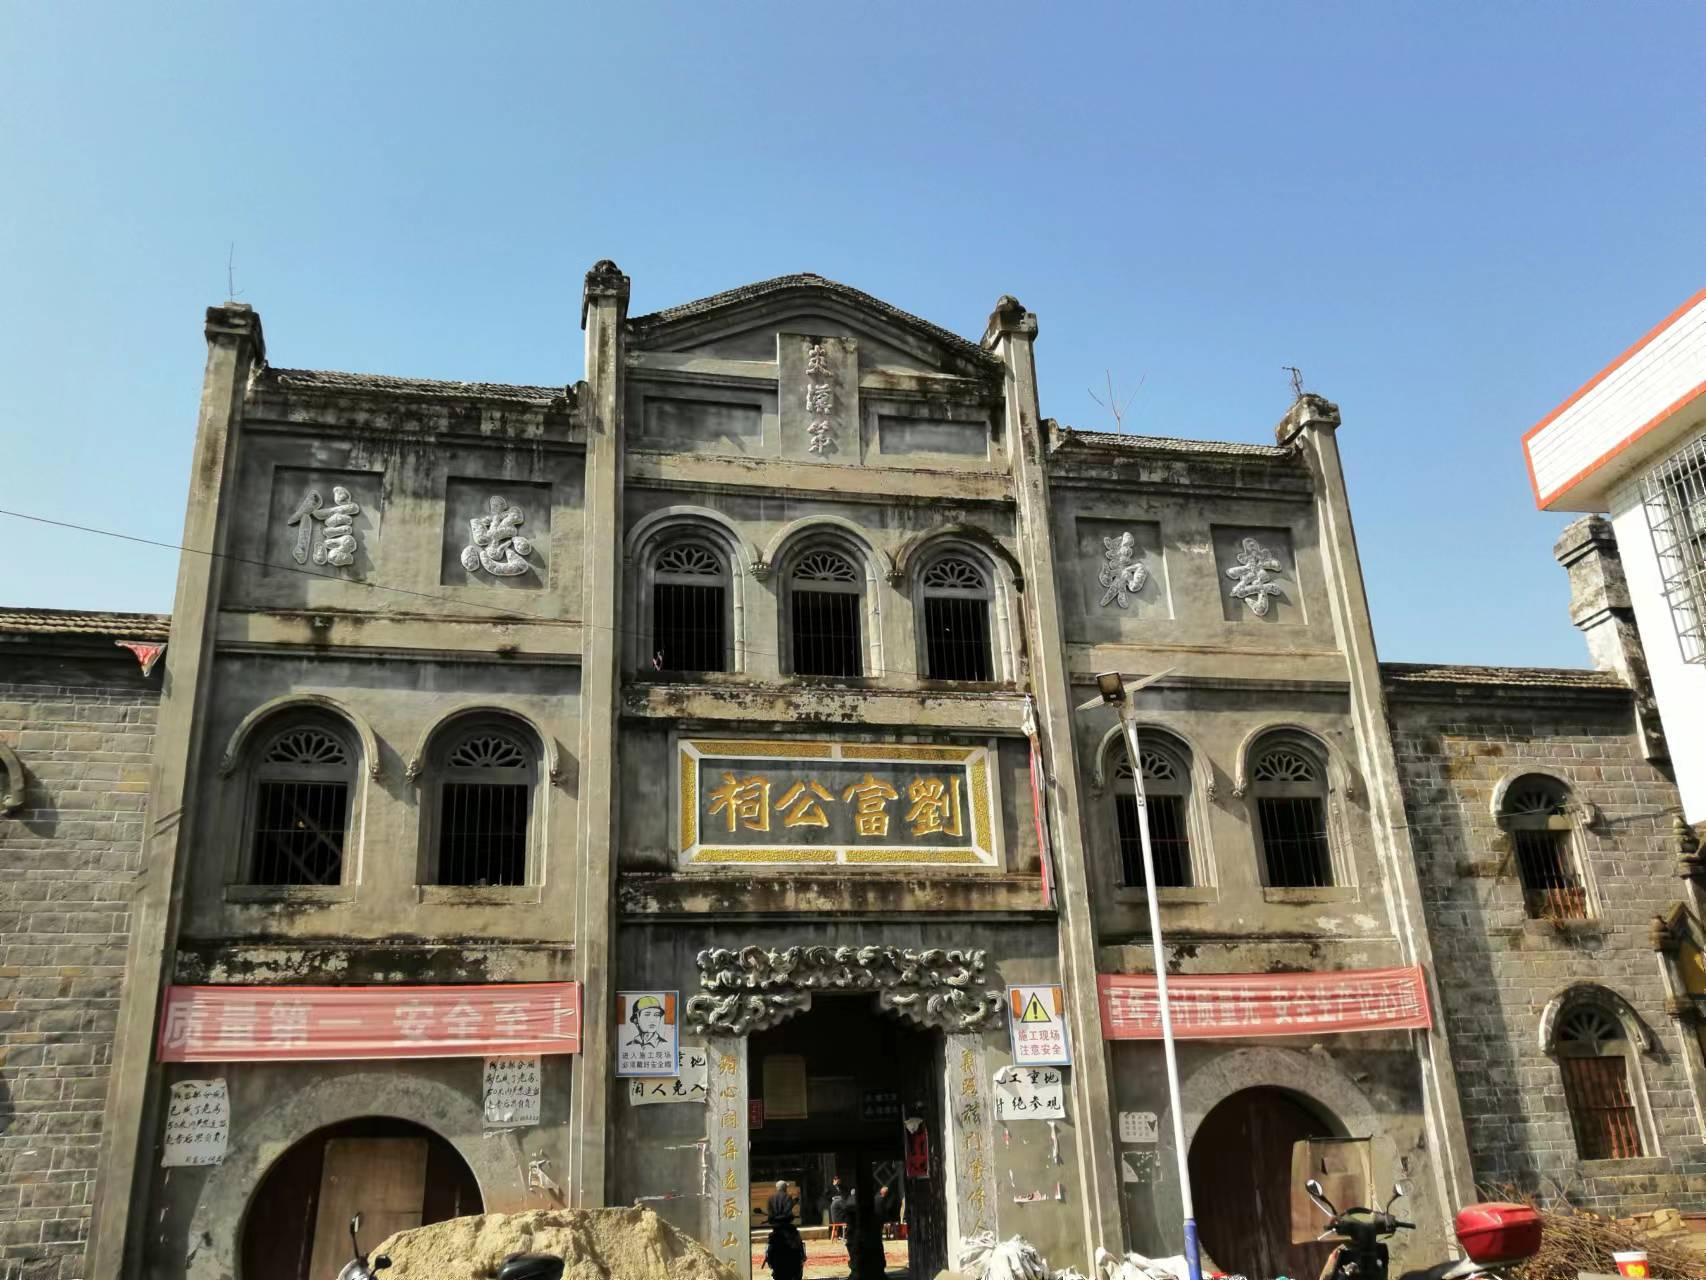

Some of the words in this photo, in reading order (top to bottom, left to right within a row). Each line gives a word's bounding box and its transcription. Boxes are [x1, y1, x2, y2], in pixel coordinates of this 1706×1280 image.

[707, 772, 963, 837] 劉富公祠
[163, 1000, 362, 1048] 质量第一
[1018, 1029, 1060, 1041] 施工现场
[622, 1051, 671, 1060] 进入施工现场
[1020, 1044, 1061, 1056] 注意安全
[622, 1061, 671, 1069] 必须戴好安全帽
